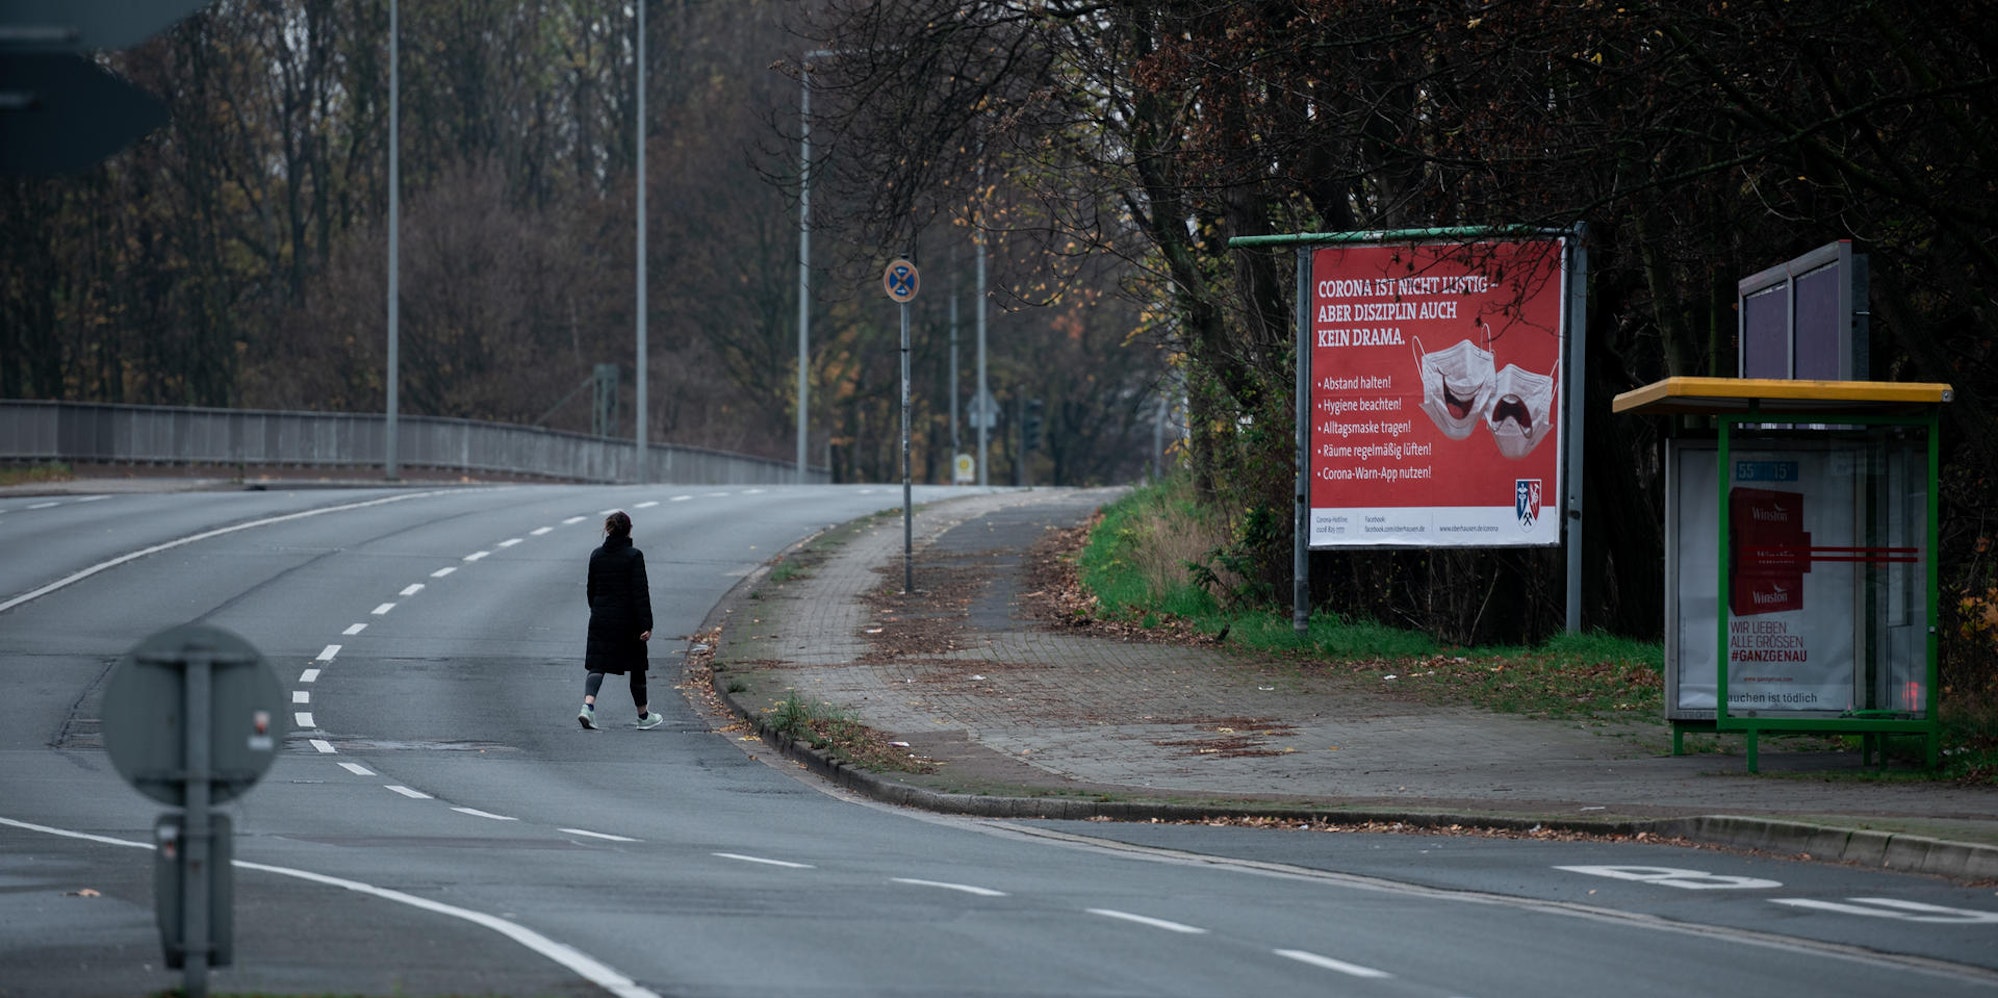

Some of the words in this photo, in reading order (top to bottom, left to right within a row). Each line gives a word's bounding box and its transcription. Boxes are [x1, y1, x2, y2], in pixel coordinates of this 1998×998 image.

[1318, 279, 1373, 298] CORONA
[1375, 279, 1395, 296] IST
[1398, 277, 1439, 295] NICHT
[1442, 275, 1487, 294] LUSTIG
[1318, 304, 1351, 322] ABER
[1354, 302, 1416, 321] DISZIPLIN
[1418, 301, 1457, 319] AUCH
[1318, 329, 1350, 347] KEIN
[1352, 327, 1405, 346] DRAMA.
[1323, 376, 1358, 390] Abstand
[1360, 376, 1391, 388] halten!
[1323, 399, 1358, 415] Hygiene
[1360, 397, 1401, 411] beachten!
[1323, 421, 1379, 437] Alltagsmaske
[1380, 420, 1411, 436] tragen!
[1323, 444, 1352, 457] Räume
[1353, 442, 1401, 460] regelmäßig
[1403, 442, 1432, 456] lüften!
[1323, 465, 1398, 482] Corona-Warn-App
[1400, 465, 1432, 479] nutzen!
[1752, 507, 1788, 522] Winston
[1752, 591, 1788, 604] Winston
[1730, 621, 1749, 634] WIR
[1752, 621, 1787, 634] LIEBEN
[1730, 635, 1753, 648] ALLE
[1755, 634, 1804, 648] GRÖSSEN
[1731, 650, 1807, 662] #GANZGENAU
[1727, 692, 1766, 703] auchen
[1768, 692, 1780, 703] ist
[1783, 692, 1817, 703] tödlich
